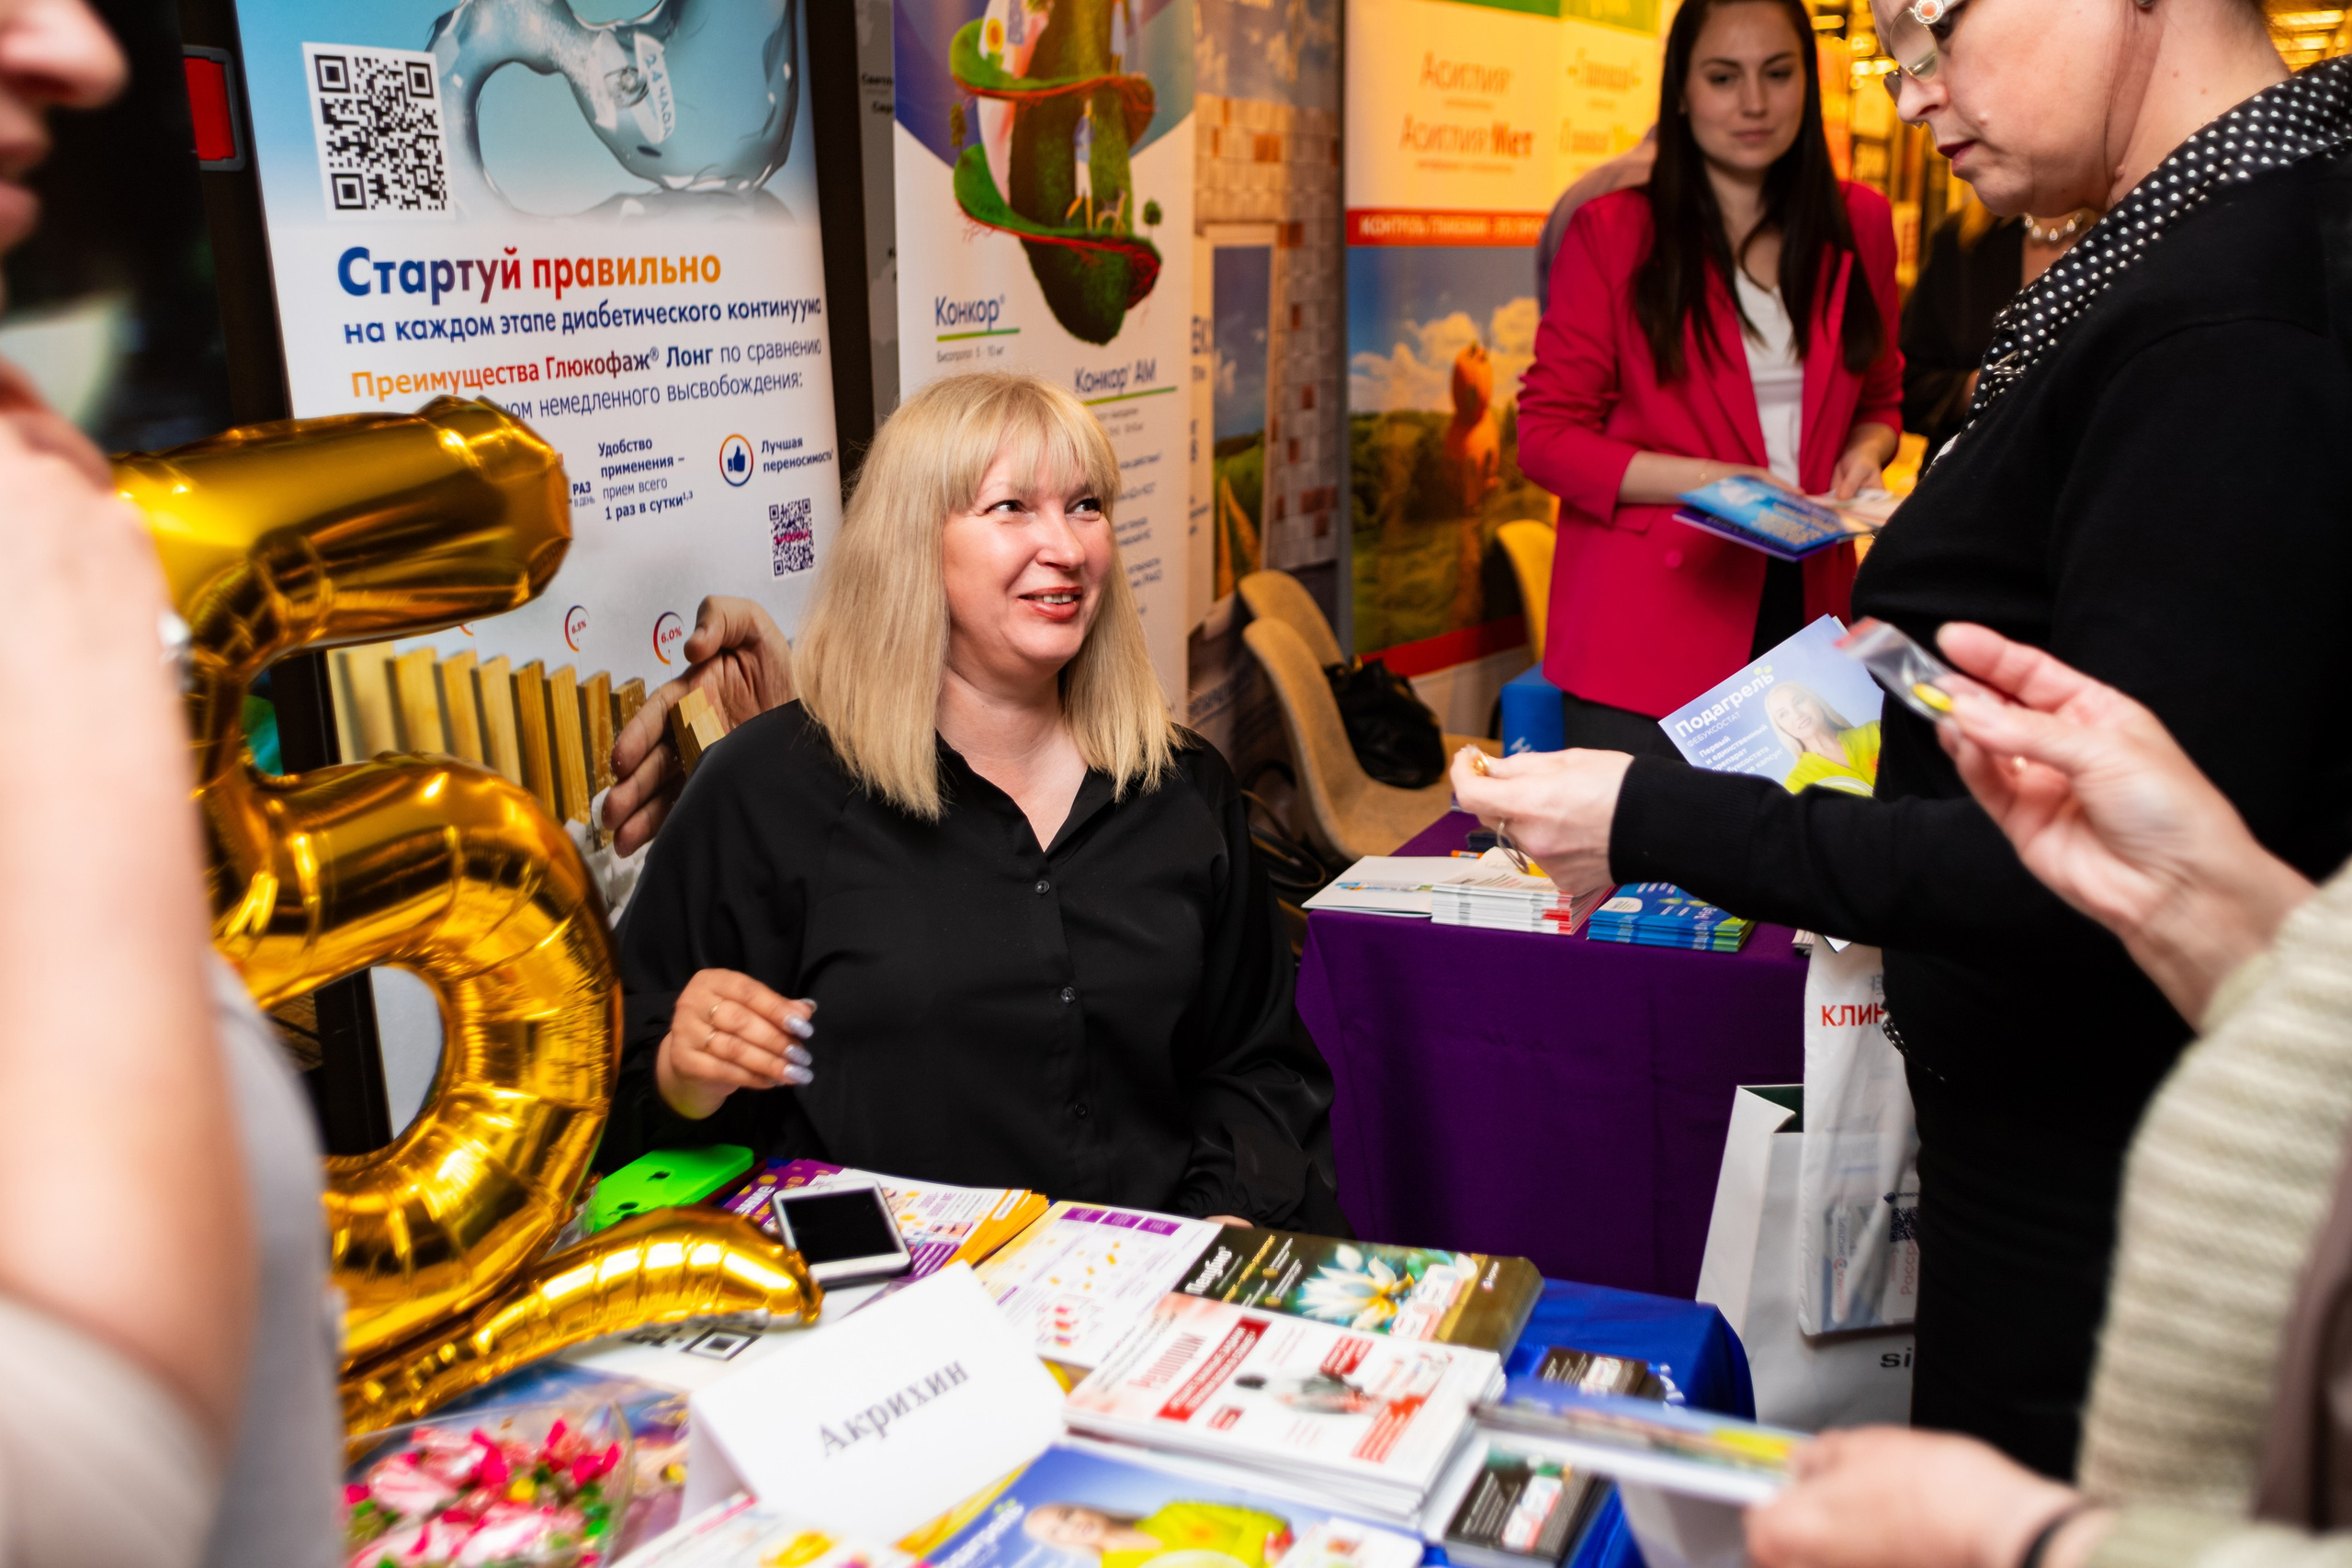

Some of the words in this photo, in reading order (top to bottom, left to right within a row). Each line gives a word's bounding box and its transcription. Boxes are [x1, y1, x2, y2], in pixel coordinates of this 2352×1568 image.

[337, 246, 521, 306] Стартуй
[532, 254, 721, 300] правильно
[344, 321, 385, 344] на
[395, 315, 496, 343] каждом
[500, 312, 556, 334] этапе
[562, 299, 721, 335] диабетического
[728, 298, 821, 323] континуума
[351, 363, 539, 402] Преимущества
[666, 346, 714, 368] Лонг
[720, 345, 741, 364] по
[747, 338, 821, 365] сравнению
[540, 387, 661, 419] немедленного
[667, 371, 803, 402] высвобождения:
[598, 438, 653, 458] Удобство
[761, 437, 803, 456] Лучшая
[601, 456, 674, 480] применения
[572, 480, 592, 496] РАЗ
[603, 482, 635, 502] прием
[639, 477, 668, 493] всего
[605, 506, 613, 521] 1
[616, 503, 636, 522] раз
[639, 502, 646, 514] в
[571, 619, 587, 635] 6.5%
[661, 626, 683, 644] 6.0%
[1675, 673, 1774, 738] Подагрель
[1687, 711, 1741, 747] ФЕБУКСОСТАТ
[1699, 735, 1731, 758] Первый
[1713, 723, 1768, 761] единственный
[818, 1359, 971, 1458] Акрихин
